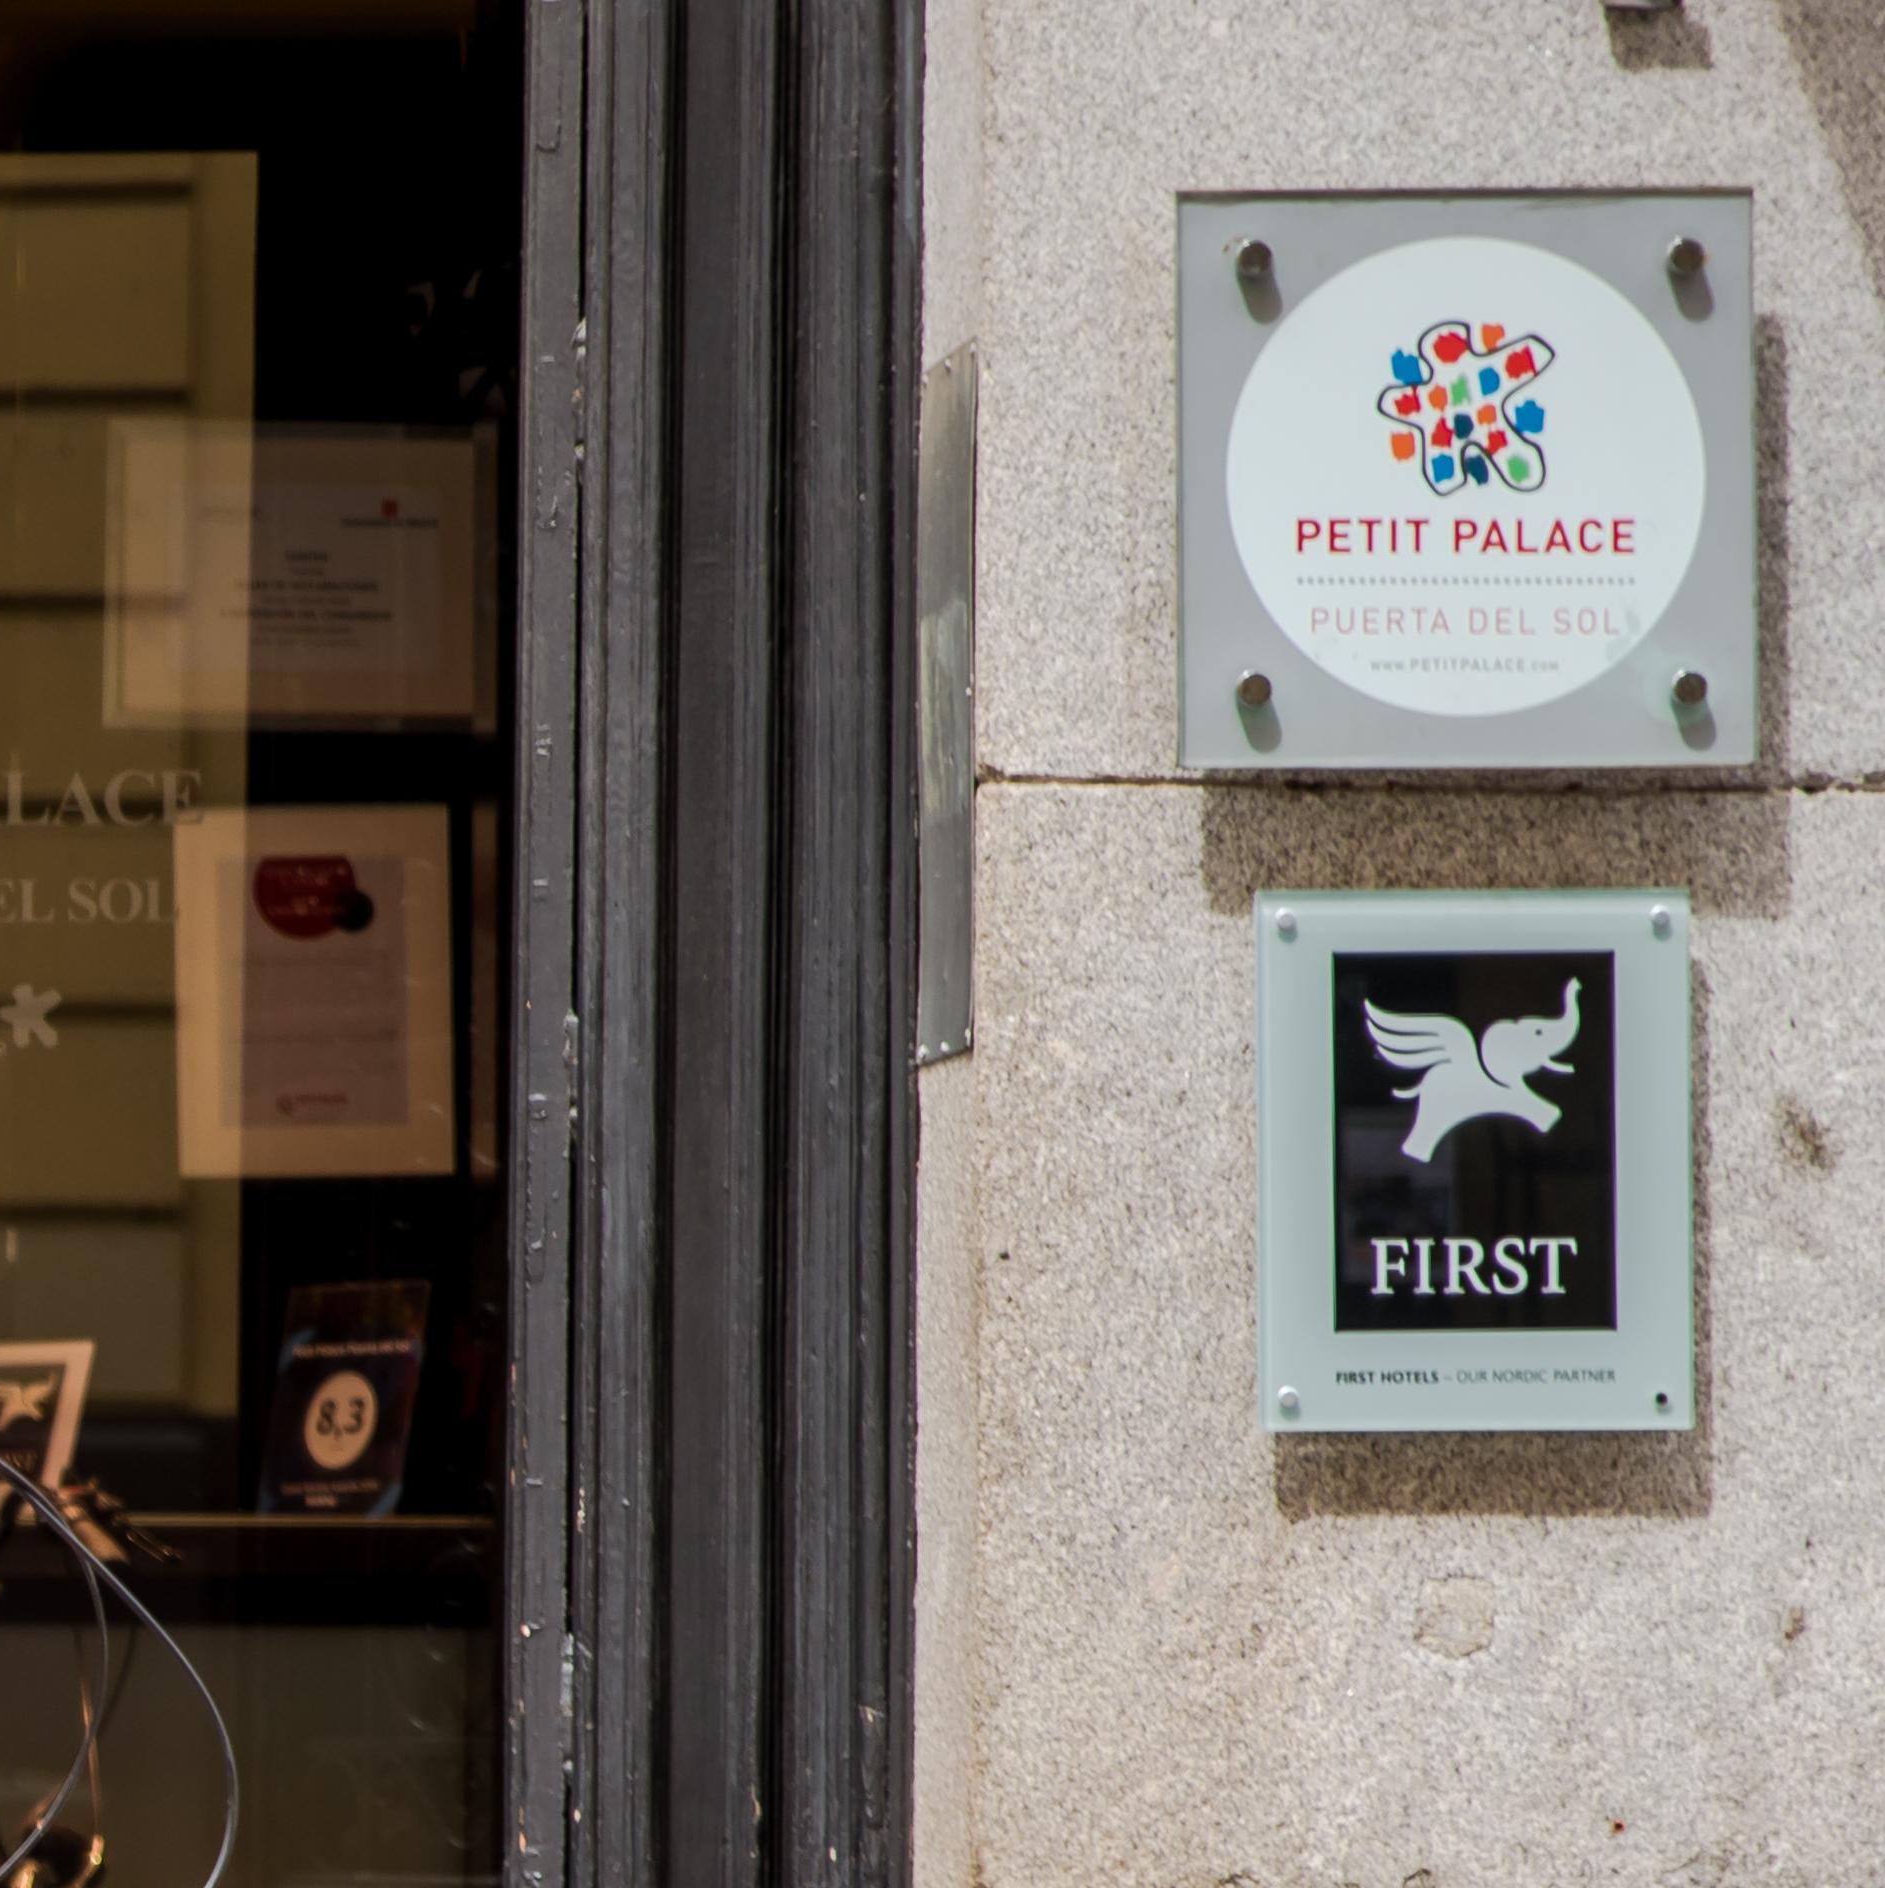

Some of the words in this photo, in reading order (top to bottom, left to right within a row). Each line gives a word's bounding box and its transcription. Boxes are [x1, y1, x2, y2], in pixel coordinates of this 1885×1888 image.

[1295, 519, 1431, 555] PETIT
[1453, 518, 1636, 554] PALACE
[1310, 608, 1451, 637] PUERTA
[1468, 607, 1536, 636] DEL
[1553, 606, 1621, 636] SOL
[66, 878, 180, 924] SOL
[1370, 1237, 1578, 1295] FIRST
[1335, 1370, 1375, 1385] FIRST
[1380, 1370, 1440, 1385] HOTELS
[1456, 1369, 1487, 1384] OUR
[1492, 1369, 1549, 1384] NORDIC
[1553, 1368, 1617, 1383] PARTNER
